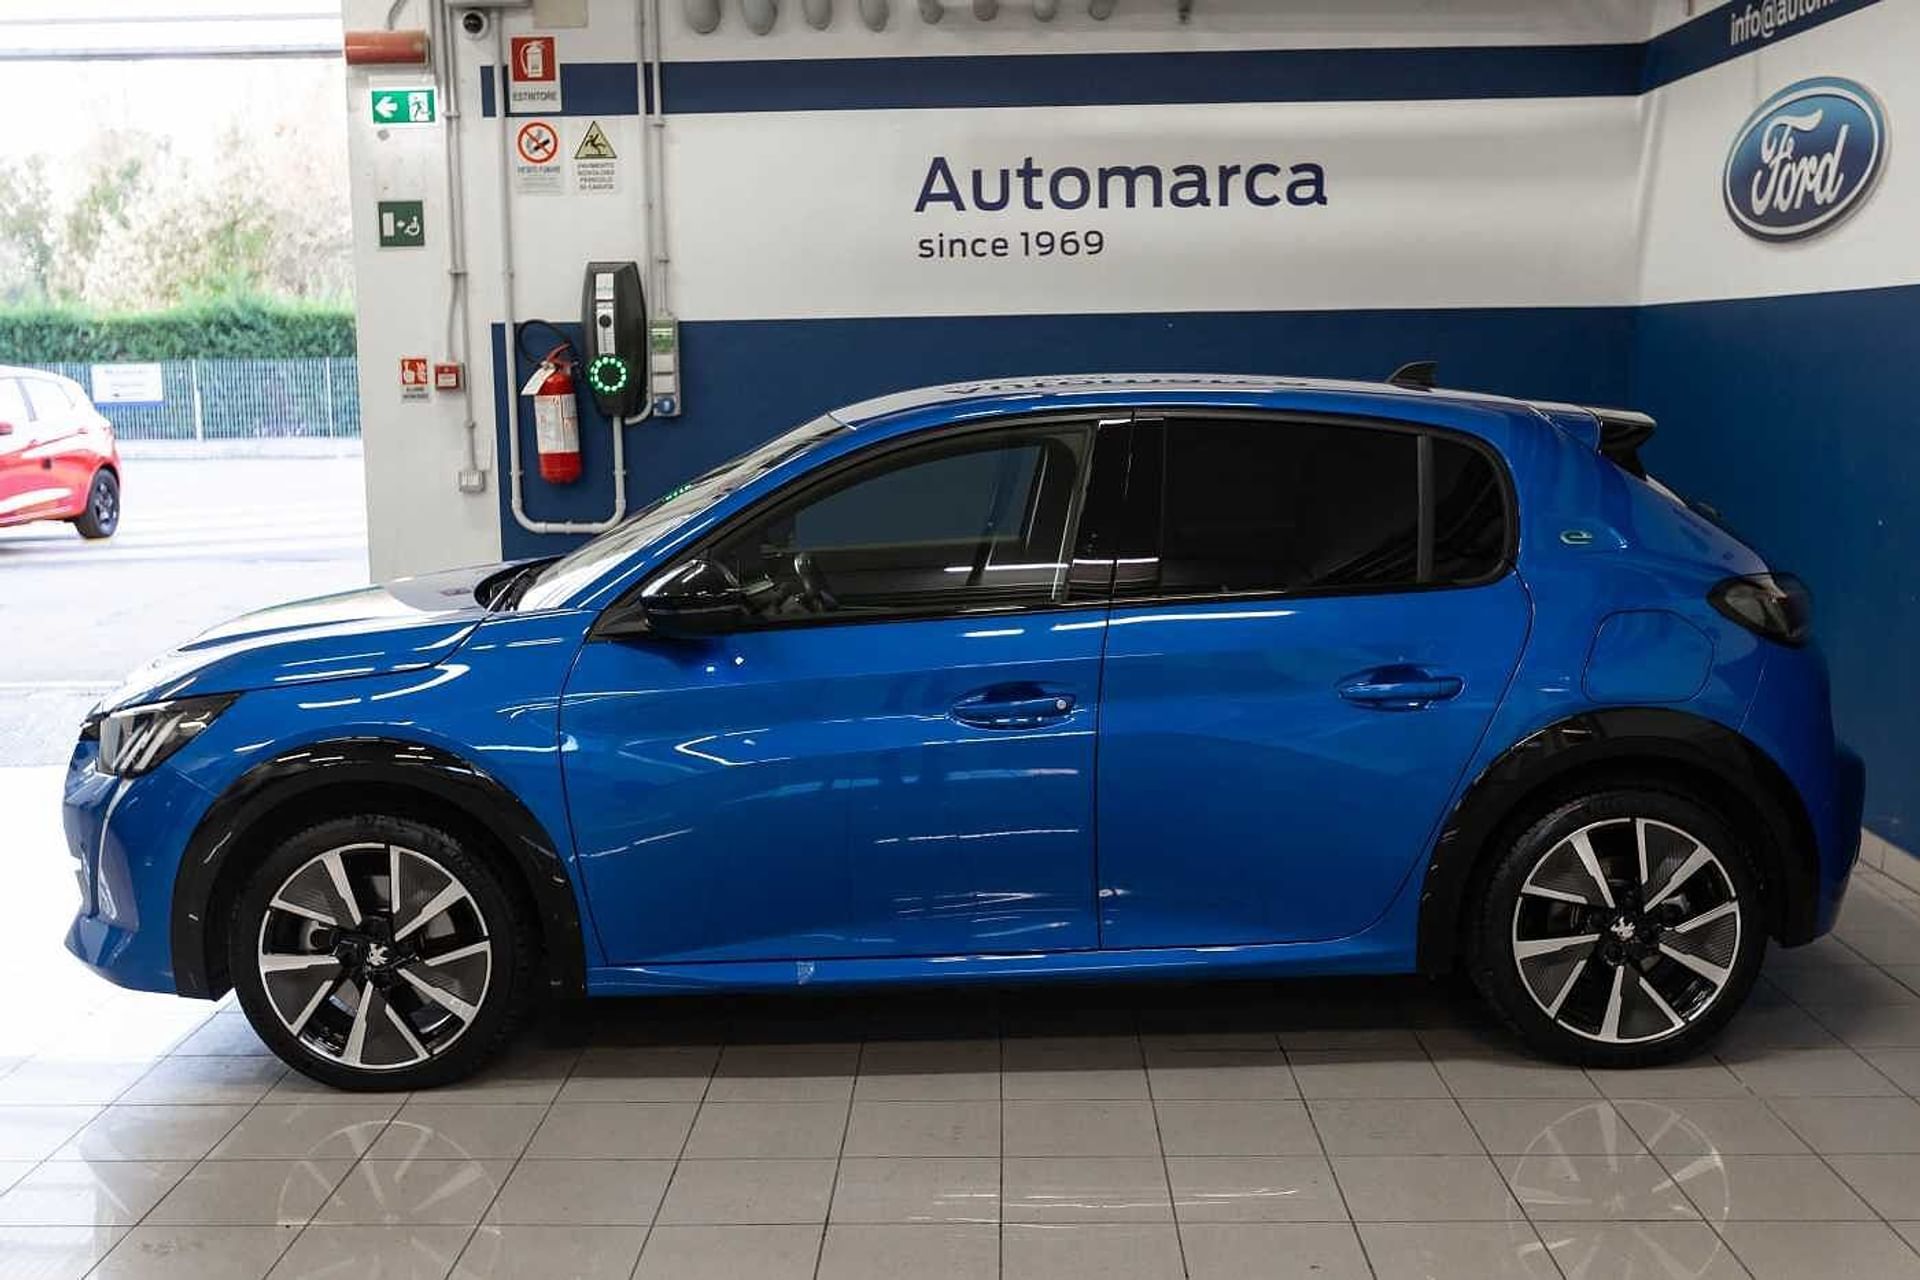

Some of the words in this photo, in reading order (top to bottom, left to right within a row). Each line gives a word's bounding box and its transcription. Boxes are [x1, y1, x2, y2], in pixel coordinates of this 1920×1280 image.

[914, 156, 1328, 212] Automarca
[1751, 108, 1849, 216] Ford
[918, 232, 1009, 258] since
[1020, 230, 1105, 257] 1969
